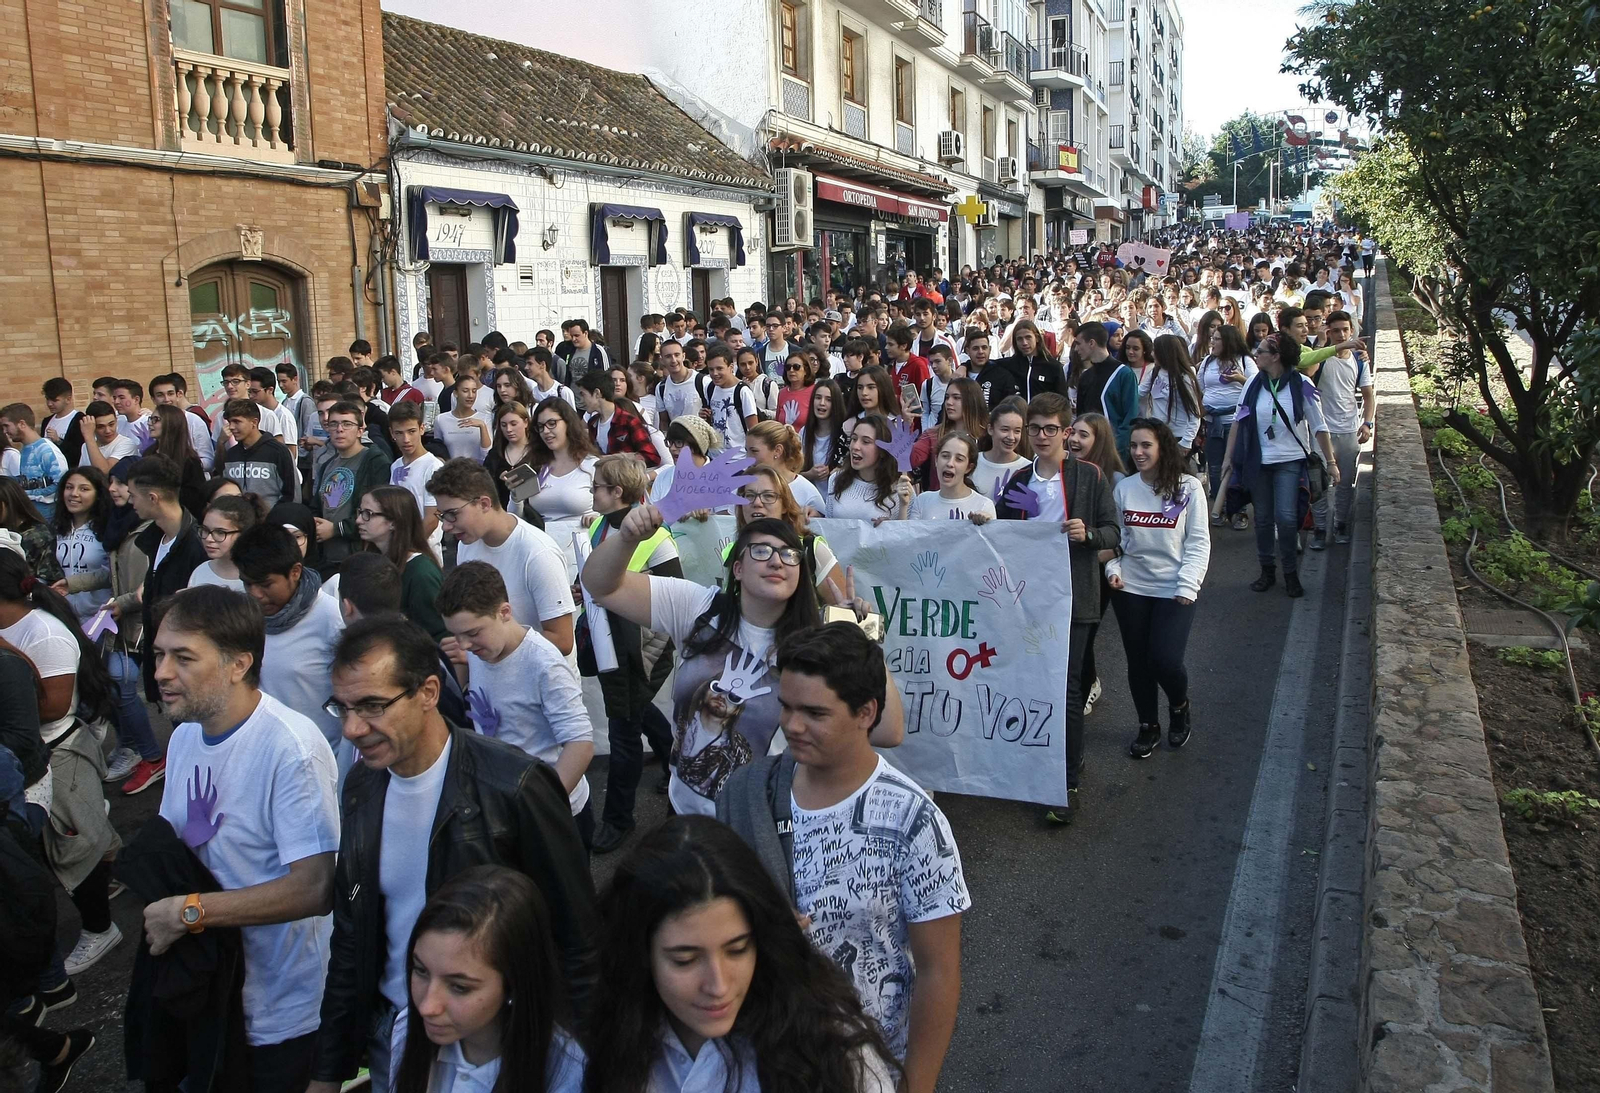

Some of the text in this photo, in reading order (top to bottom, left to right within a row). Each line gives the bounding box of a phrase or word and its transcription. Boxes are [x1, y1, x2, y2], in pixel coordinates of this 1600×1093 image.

[842, 189, 877, 208] ORTOPEDIA
[908, 204, 940, 220] SAN ANTONIO
[436, 223, 466, 247] 1947
[658, 282, 678, 291] CASTRO
[229, 463, 271, 479] adidas
[677, 471, 695, 481] NO
[675, 484, 731, 494] VIOLENCIA
[58, 542, 88, 569] 22
[870, 585, 979, 639] VERDE
[905, 680, 1053, 747] TU VOZ
[812, 897, 828, 912] YOU
[829, 895, 849, 911] PLAY
[829, 911, 855, 921] THUG
